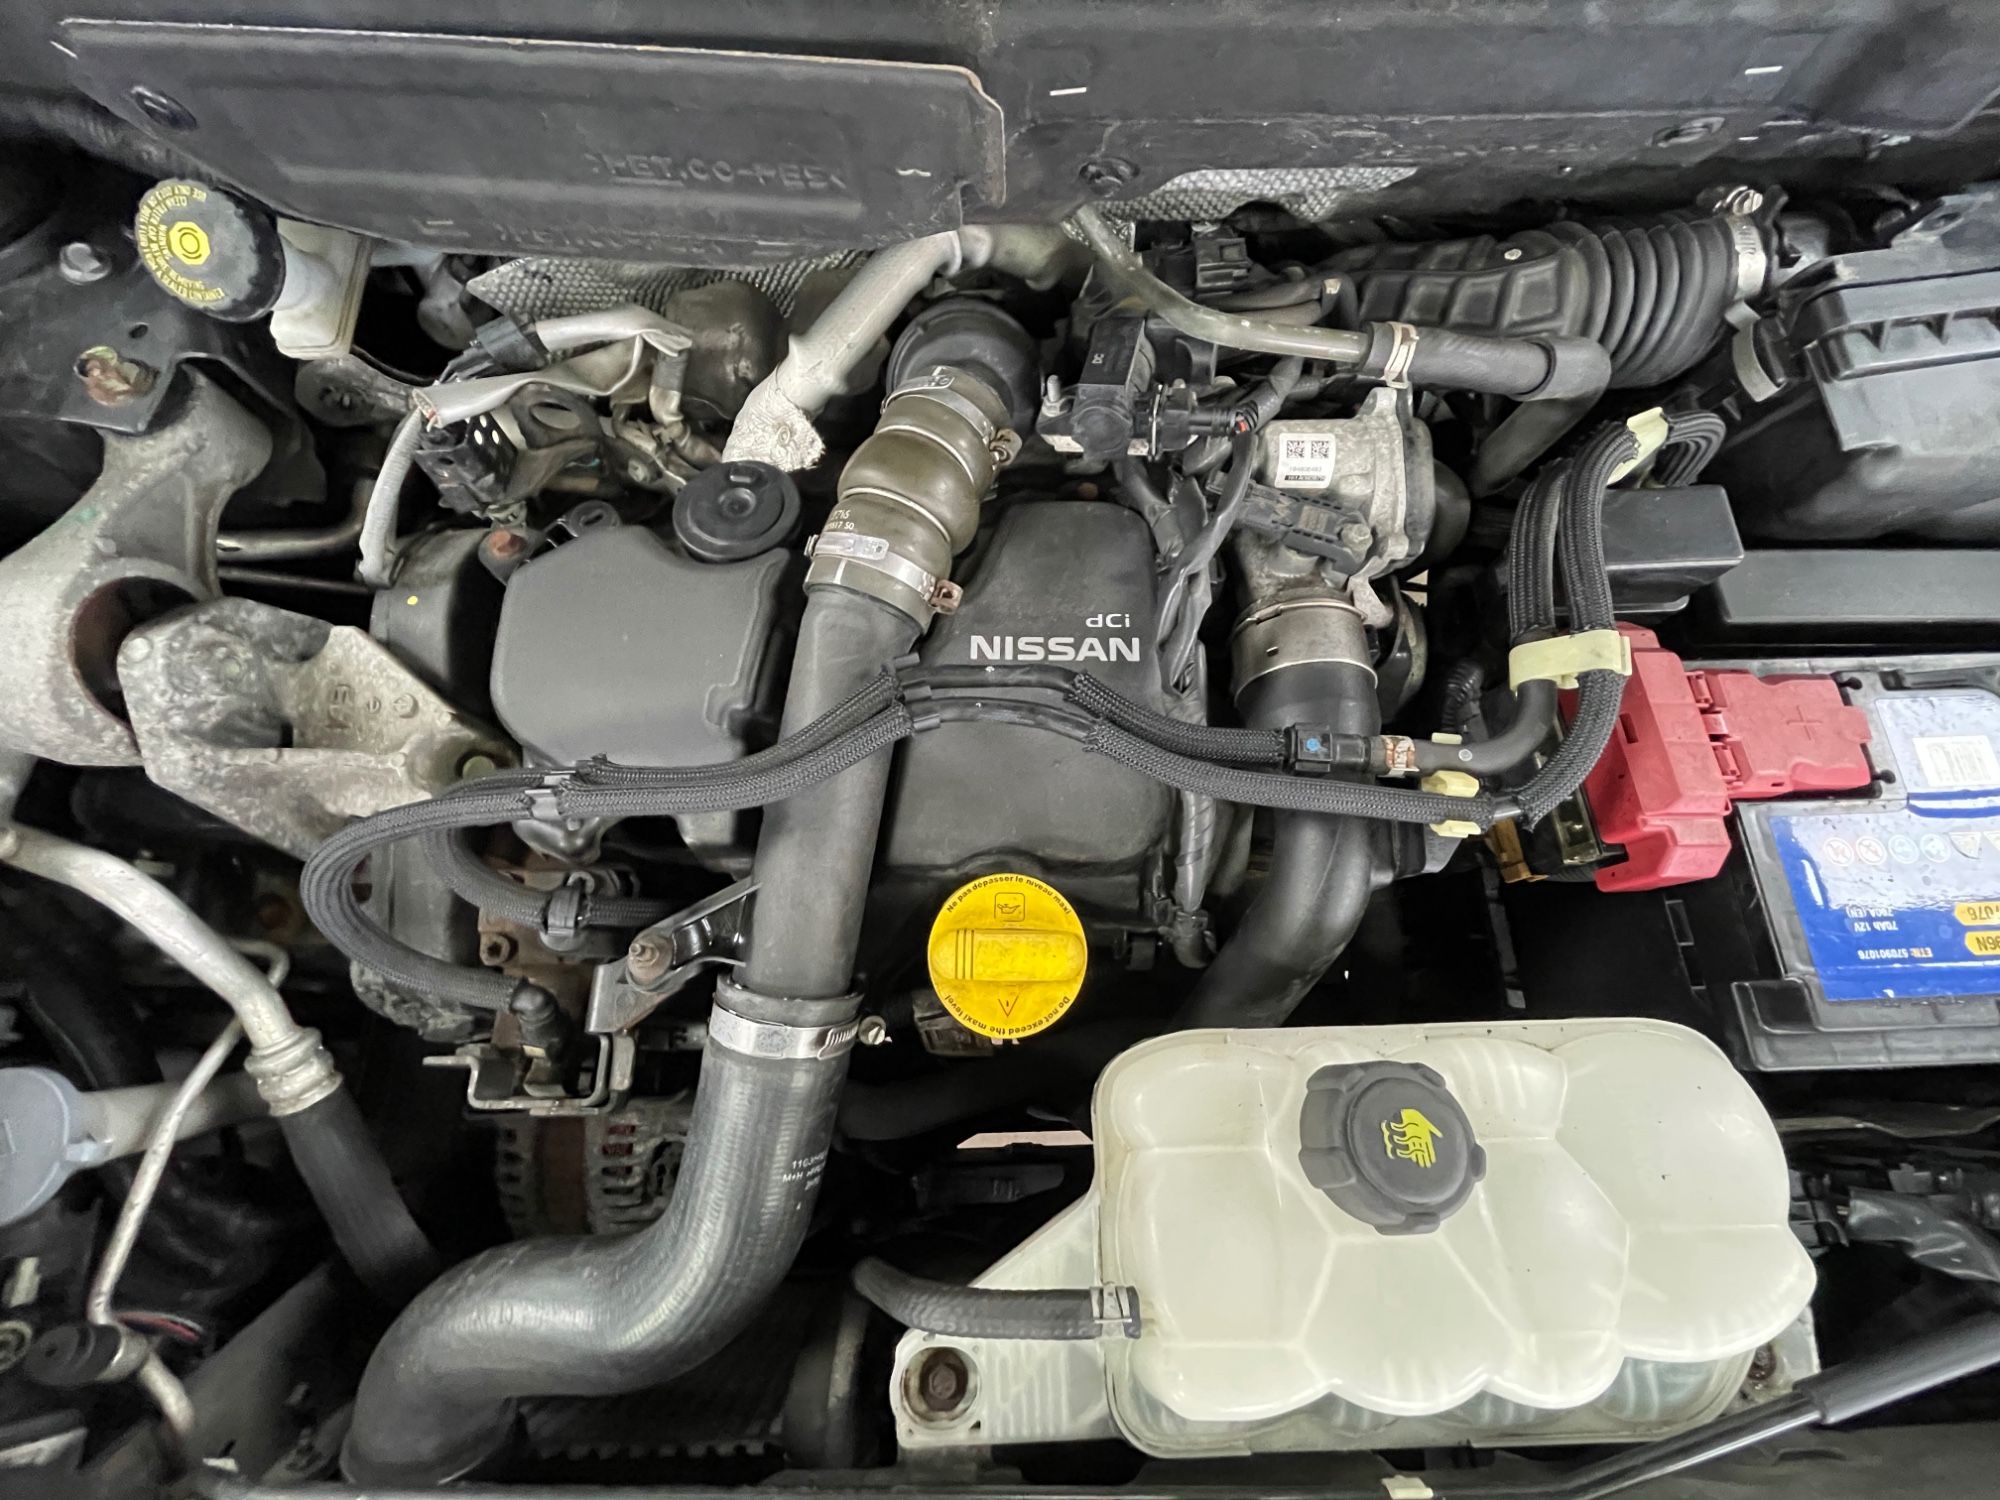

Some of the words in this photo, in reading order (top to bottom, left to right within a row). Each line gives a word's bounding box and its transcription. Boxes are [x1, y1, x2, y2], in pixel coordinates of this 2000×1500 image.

[1085, 614, 1131, 628] dCi
[970, 635, 1141, 662] NISSAN
[946, 901, 959, 913] Ne
[957, 888, 973, 902] pas
[1015, 875, 1024, 883] le
[1026, 879, 1054, 897] niveau
[1053, 895, 1073, 915] maxi
[1854, 922, 1871, 932] 12V
[944, 995, 963, 1016] level
[1058, 996, 1071, 1009] Do
[963, 1013, 987, 1030] maxi
[1045, 1008, 1060, 1022] not
[989, 1026, 1006, 1036] the
[1008, 1020, 1044, 1036] exceed
